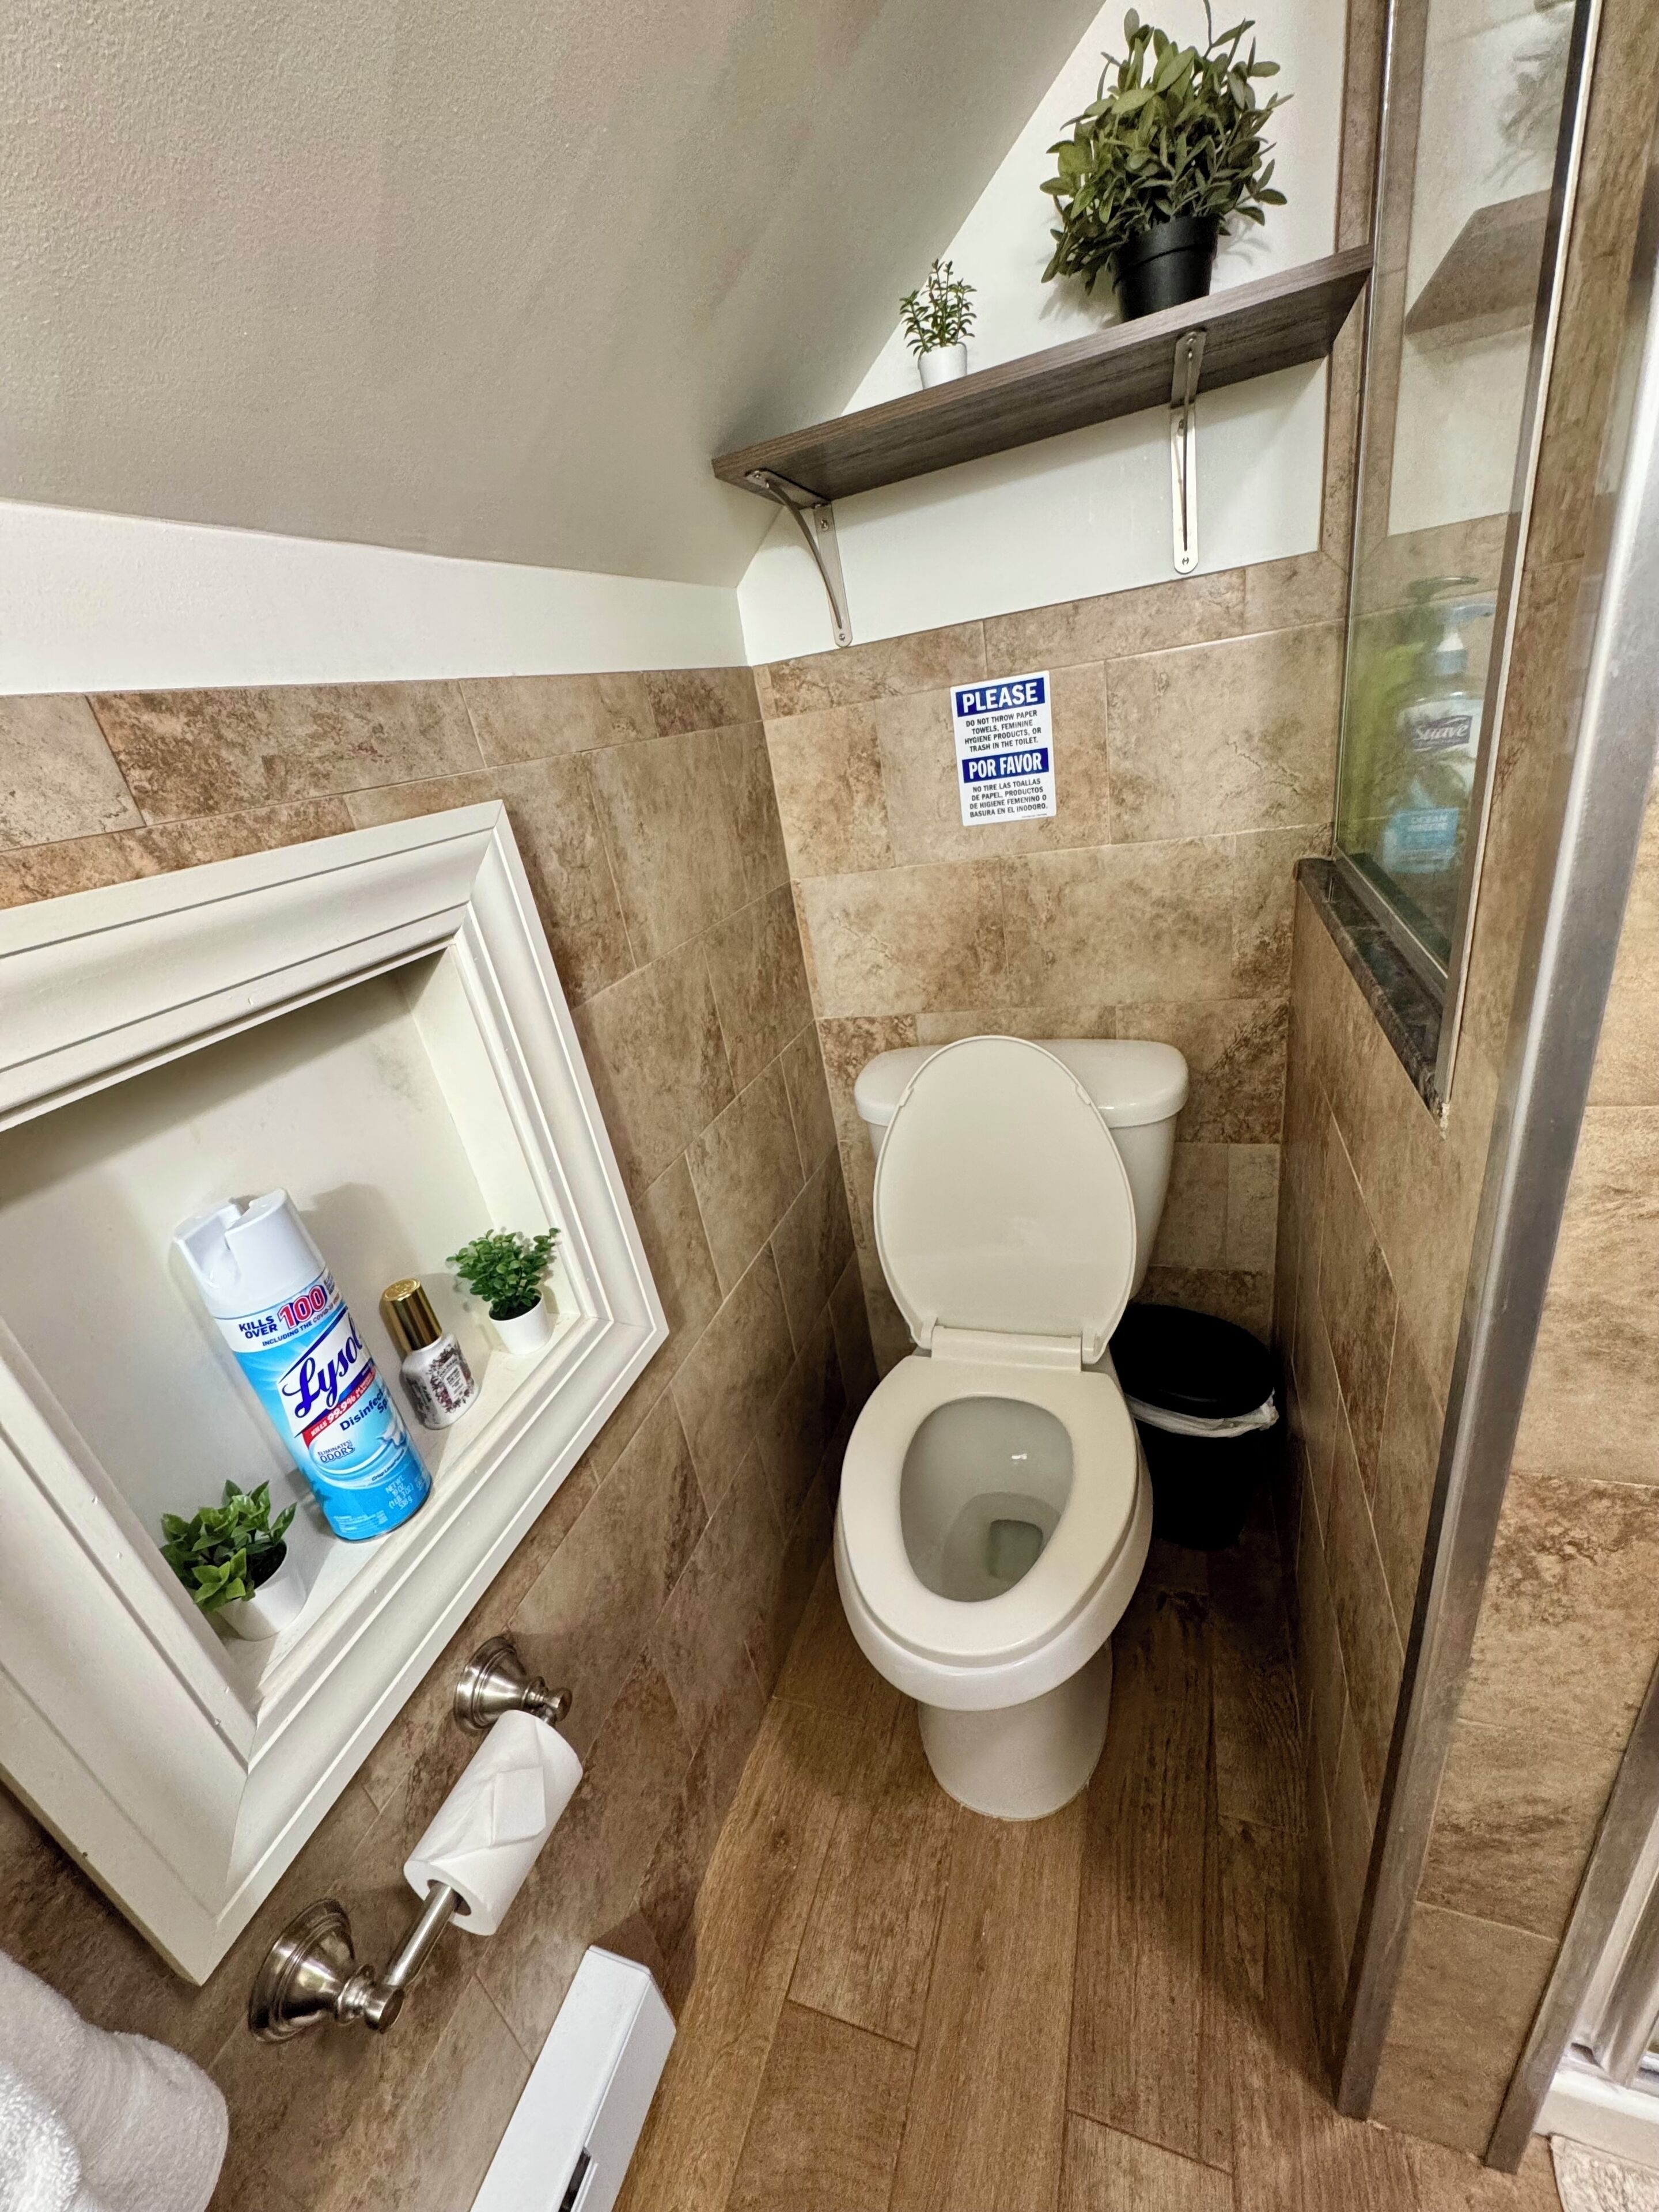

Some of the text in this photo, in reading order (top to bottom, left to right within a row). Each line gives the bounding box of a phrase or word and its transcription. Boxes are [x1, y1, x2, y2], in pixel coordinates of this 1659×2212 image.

[963, 682, 1038, 713] PLEASE
[977, 717, 989, 725] NOT
[991, 713, 1014, 723] THROW
[1017, 710, 1037, 719] PAPER
[972, 719, 1033, 734] TOWELS, FEMININE
[1412, 724, 1468, 741] Suave
[965, 734, 991, 744] HYGIENE
[994, 729, 1031, 740] PRODUCTS,
[969, 744, 990, 752] TRASH
[1014, 736, 1038, 745] TOILET.
[968, 752, 1042, 779] POR FAVOR
[1013, 778, 1041, 787] TOALLAS
[982, 791, 1003, 800] PAPEL,
[1005, 786, 1043, 797] PRODUCTOS
[979, 800, 1005, 808] HIGIENE
[1007, 796, 1040, 805] FEMENINO
[970, 809, 995, 818] BASURA
[1017, 803, 1048, 812] INODORO.
[238, 1285, 328, 1332] KILLS 100
[244, 1323, 278, 1339] OVER
[262, 1328, 300, 1346] INCLUDING
[299, 1321, 313, 1331] THE
[282, 1312, 362, 1418] Lysol
[327, 1394, 356, 1423] 99.9%
[317, 1440, 354, 1456] ELIMINATES
[320, 1446, 355, 1464] ODORS
